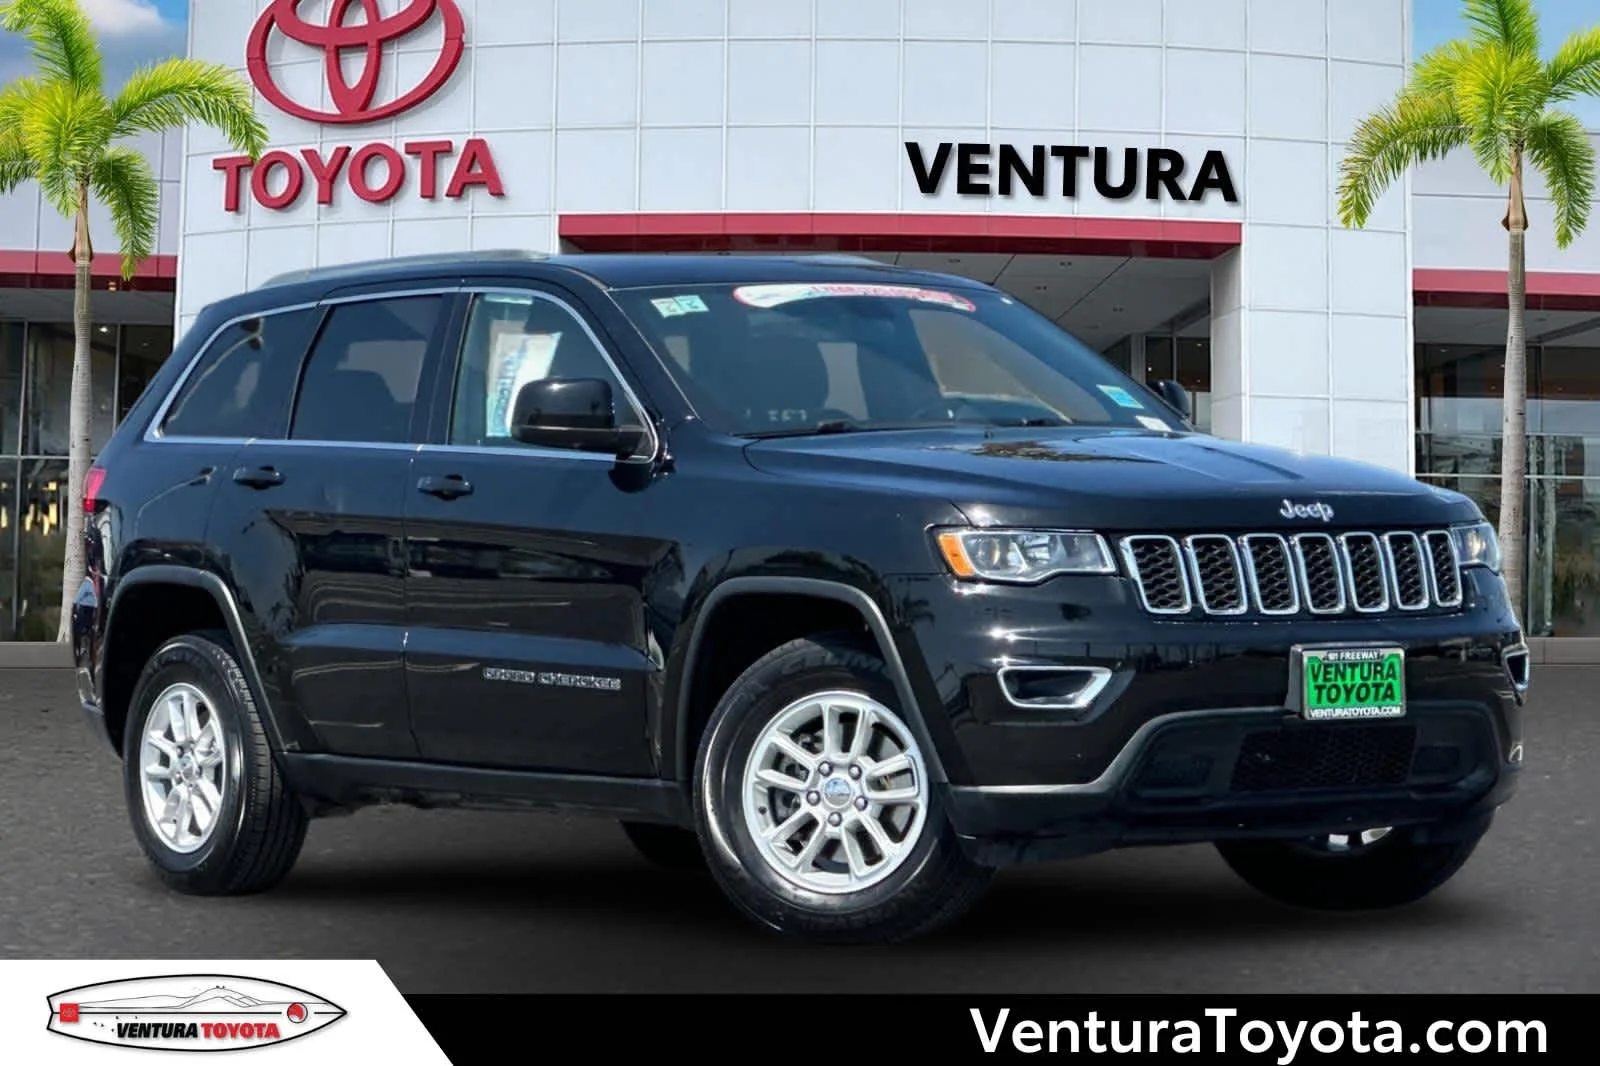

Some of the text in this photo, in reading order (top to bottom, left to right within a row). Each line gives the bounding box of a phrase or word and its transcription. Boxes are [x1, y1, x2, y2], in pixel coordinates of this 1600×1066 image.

[212, 138, 505, 213] TOYOTA
[904, 141, 1239, 203] VENTURA
[1280, 499, 1334, 522] Jeep
[1340, 651, 1379, 660] FREEWAY
[1310, 661, 1397, 682] VENTURA
[1314, 682, 1396, 704] TOYOTA
[1309, 706, 1401, 718] VENTURATOYOTA.COM
